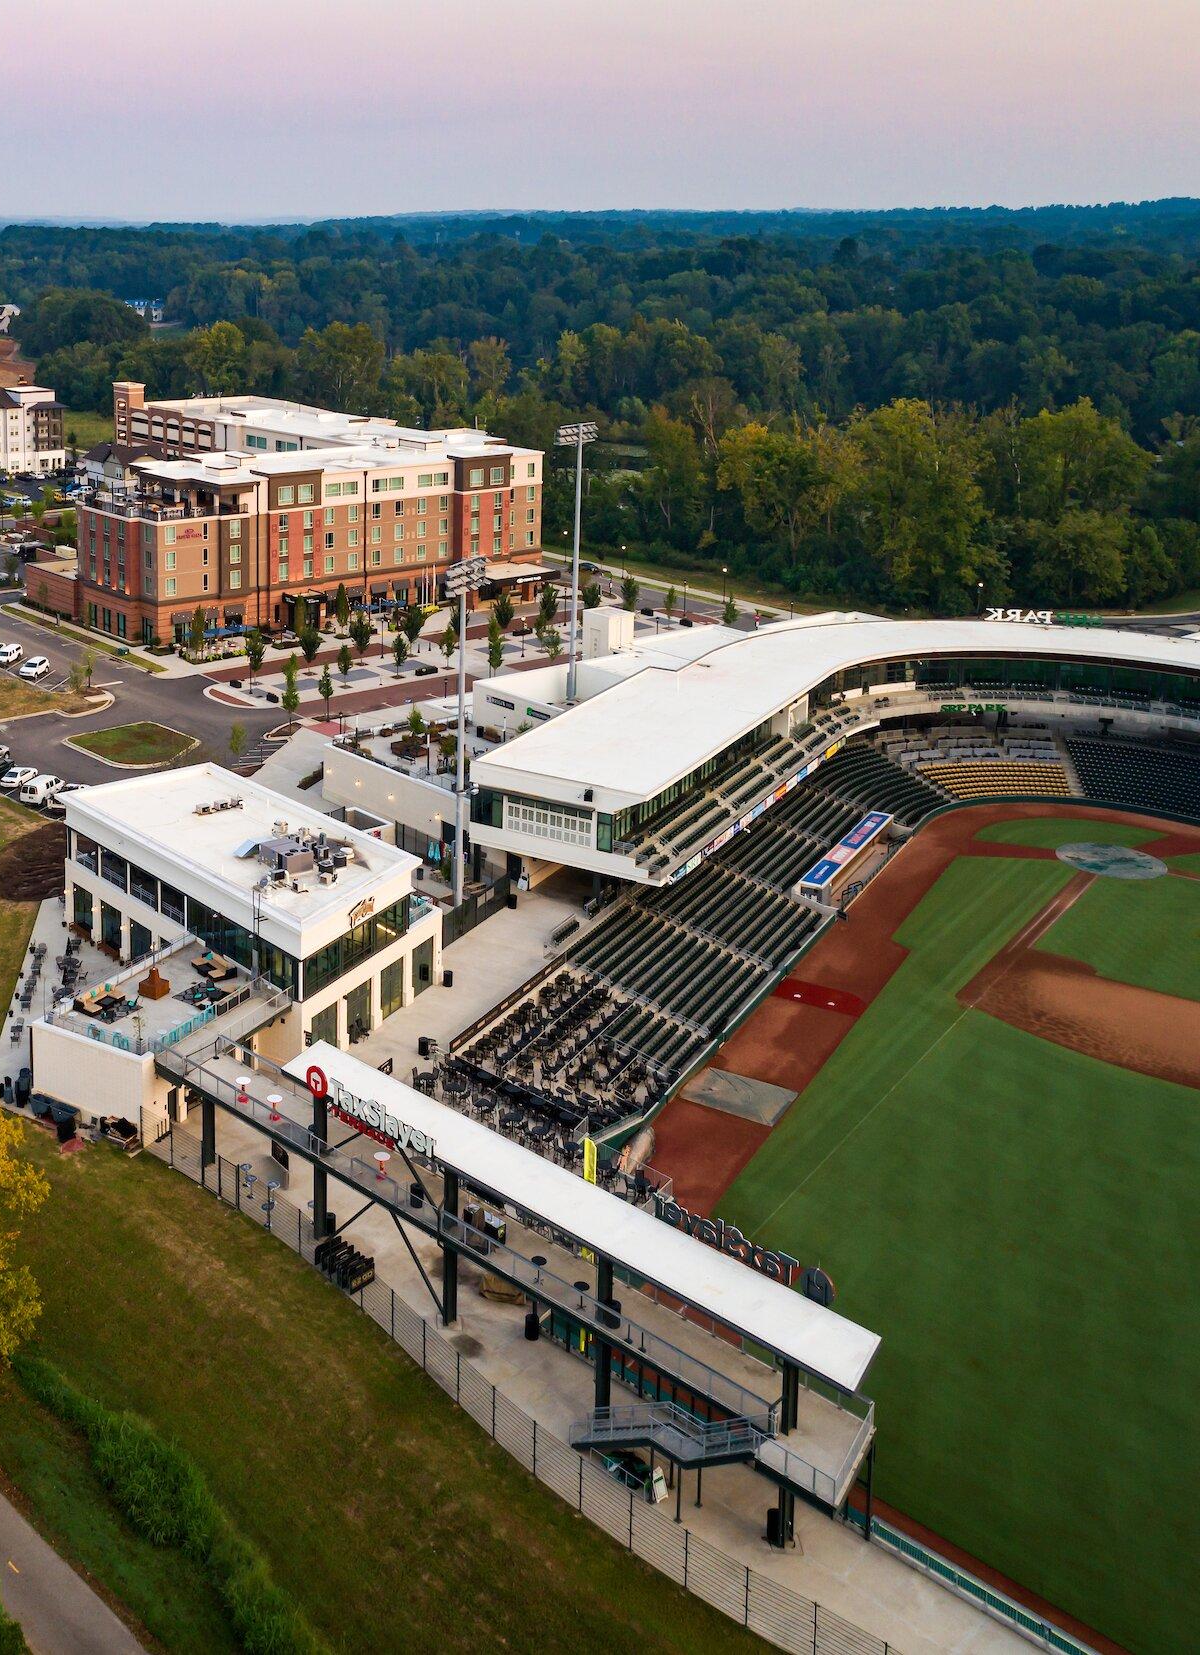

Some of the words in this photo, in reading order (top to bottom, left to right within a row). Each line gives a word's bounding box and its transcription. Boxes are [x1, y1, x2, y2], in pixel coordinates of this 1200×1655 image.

[940, 704, 966, 712] SRP
[968, 704, 1007, 713] PARK
[330, 1077, 437, 1159] TaxSlayer
